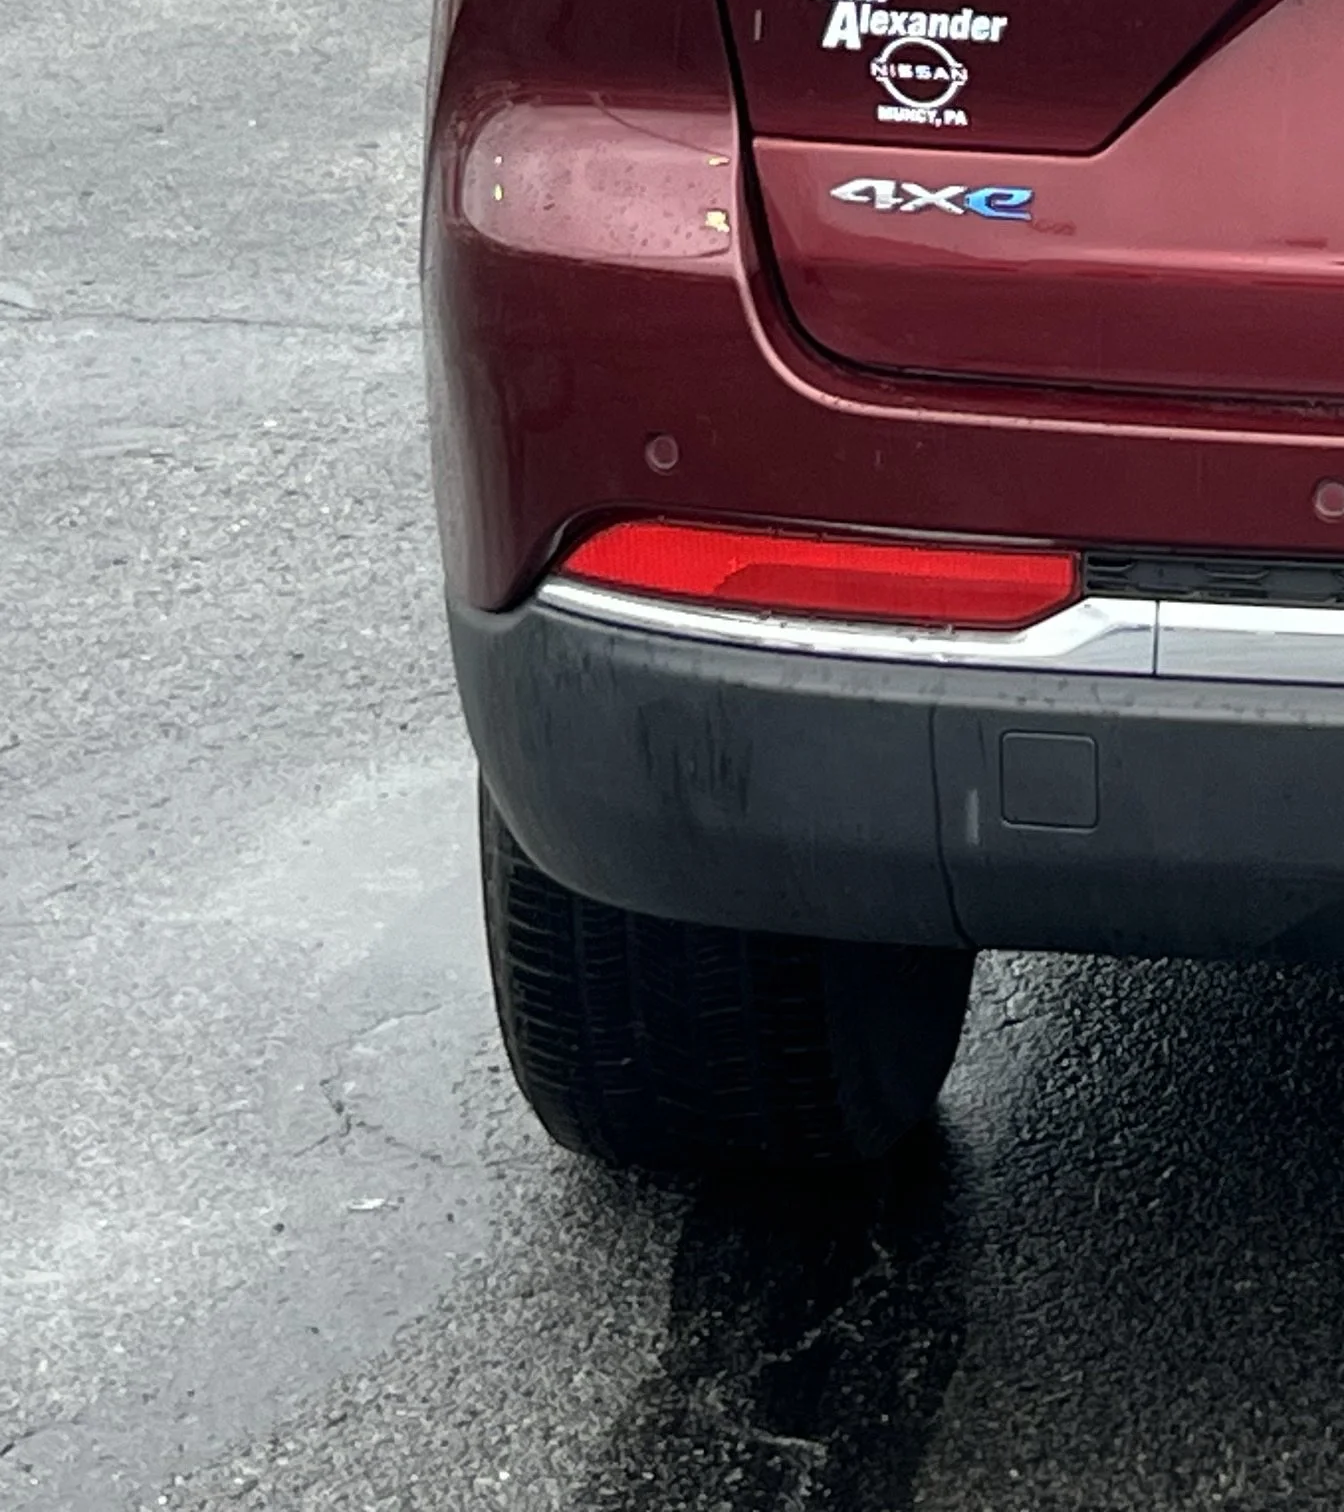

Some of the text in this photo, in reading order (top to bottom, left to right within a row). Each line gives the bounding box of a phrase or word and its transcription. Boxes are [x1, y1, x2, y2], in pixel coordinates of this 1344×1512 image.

[822, 1, 1008, 49] Alexander
[870, 62, 968, 82] NISSAN
[943, 109, 968, 126] PA
